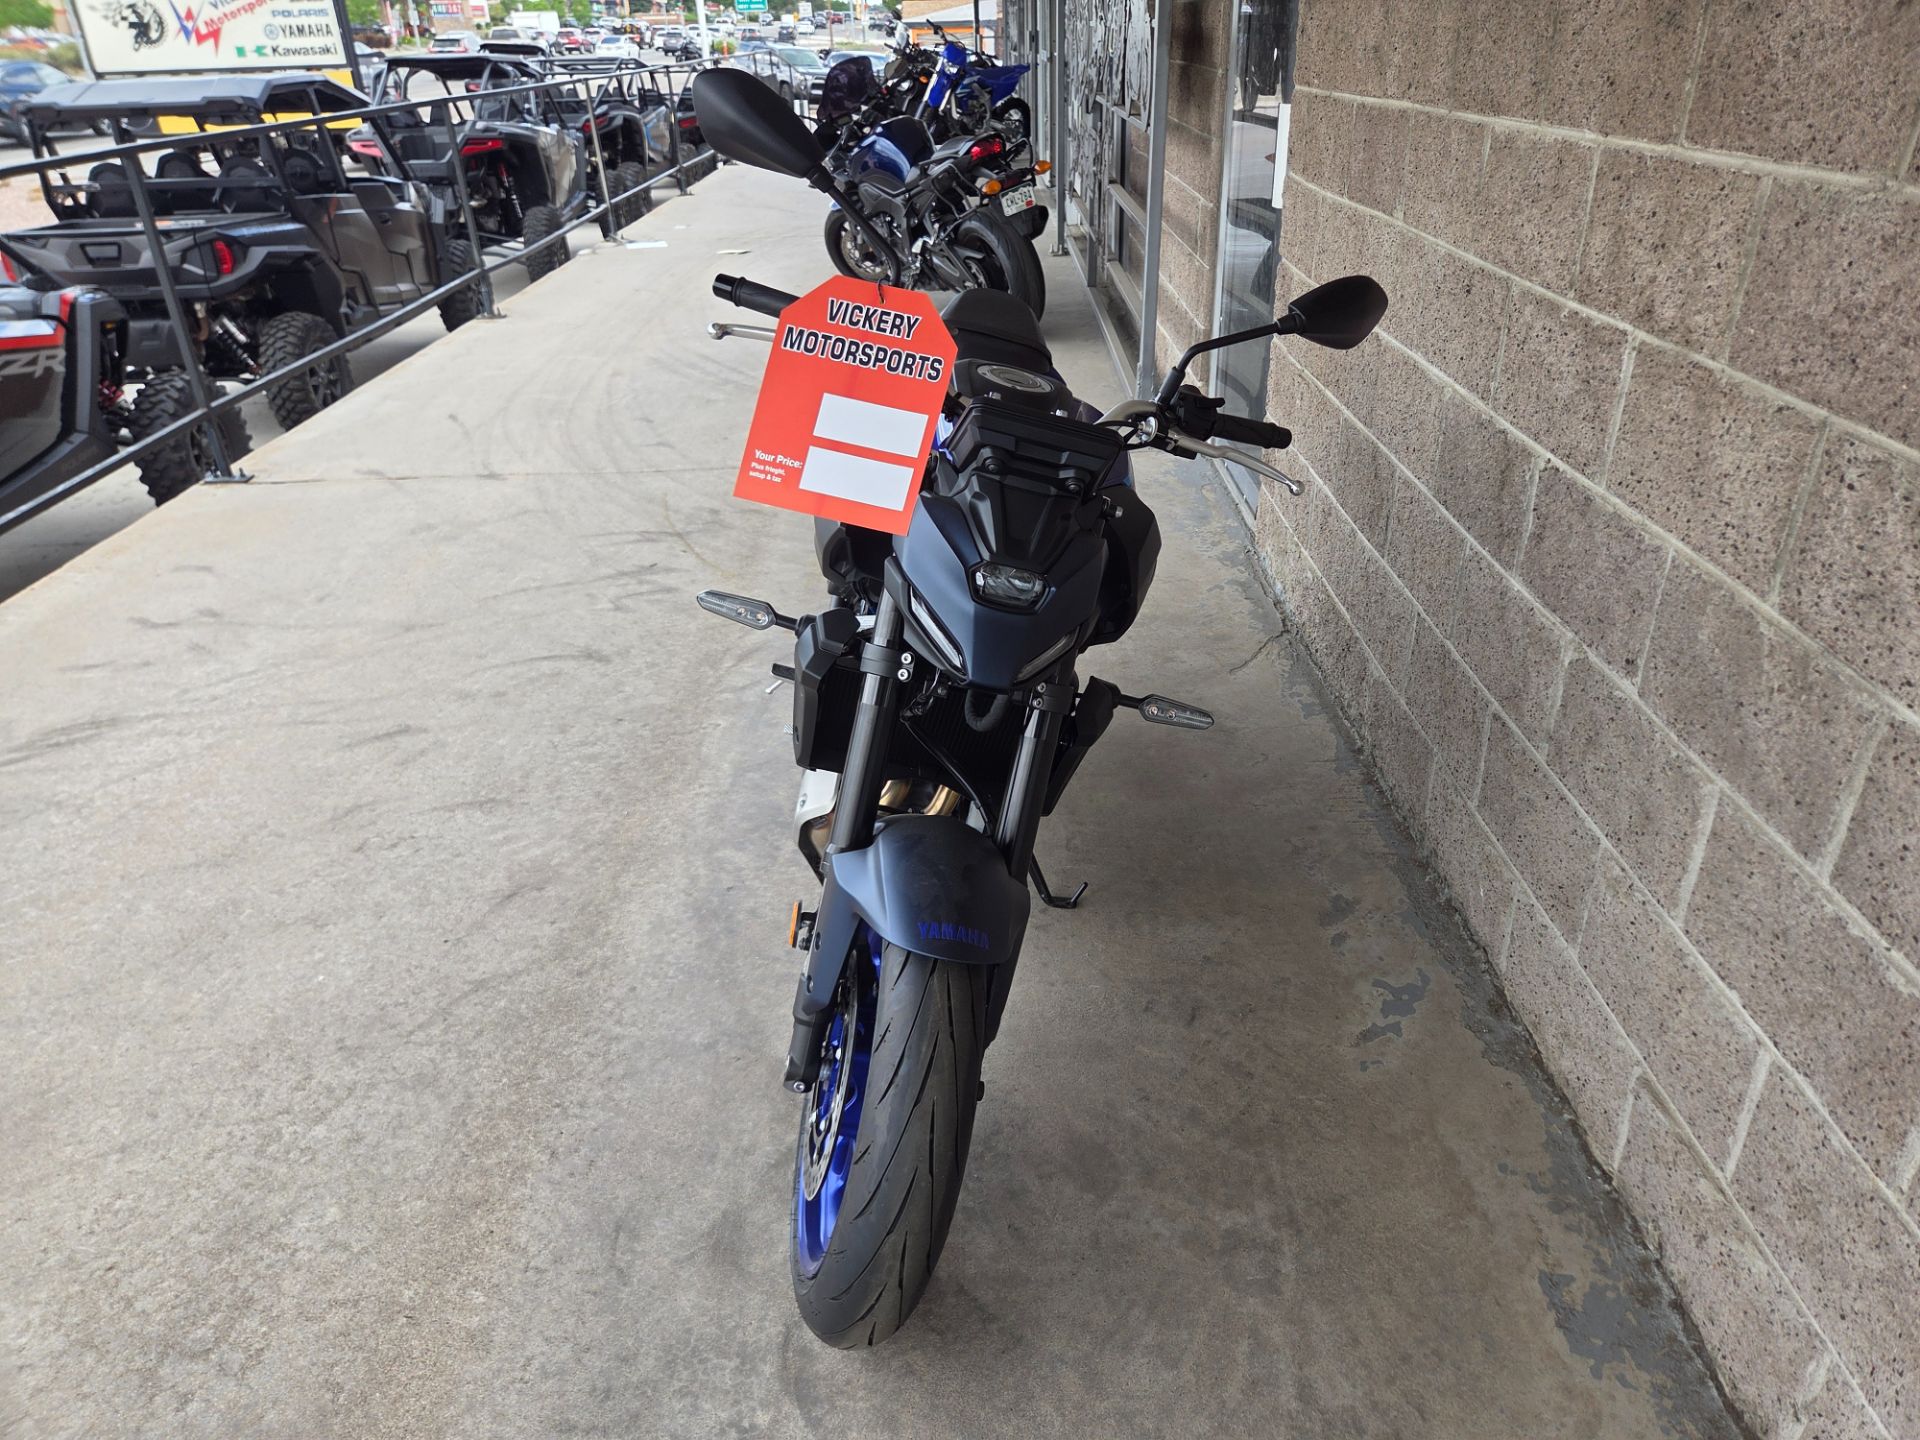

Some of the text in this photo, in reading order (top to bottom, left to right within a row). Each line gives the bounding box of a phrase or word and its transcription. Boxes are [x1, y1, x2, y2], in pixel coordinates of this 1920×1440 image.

[271, 8, 329, 18] POLARIS
[279, 23, 334, 39] YAMAHA
[271, 42, 338, 56] Kawasaki
[827, 297, 921, 340] VICKERY
[781, 325, 944, 382] MOTORSPORTS
[750, 462, 764, 471] Plus
[754, 449, 803, 469] Your Price:
[749, 471, 766, 480] setup
[771, 475, 782, 483] tax
[918, 921, 989, 950] YAMAHA
